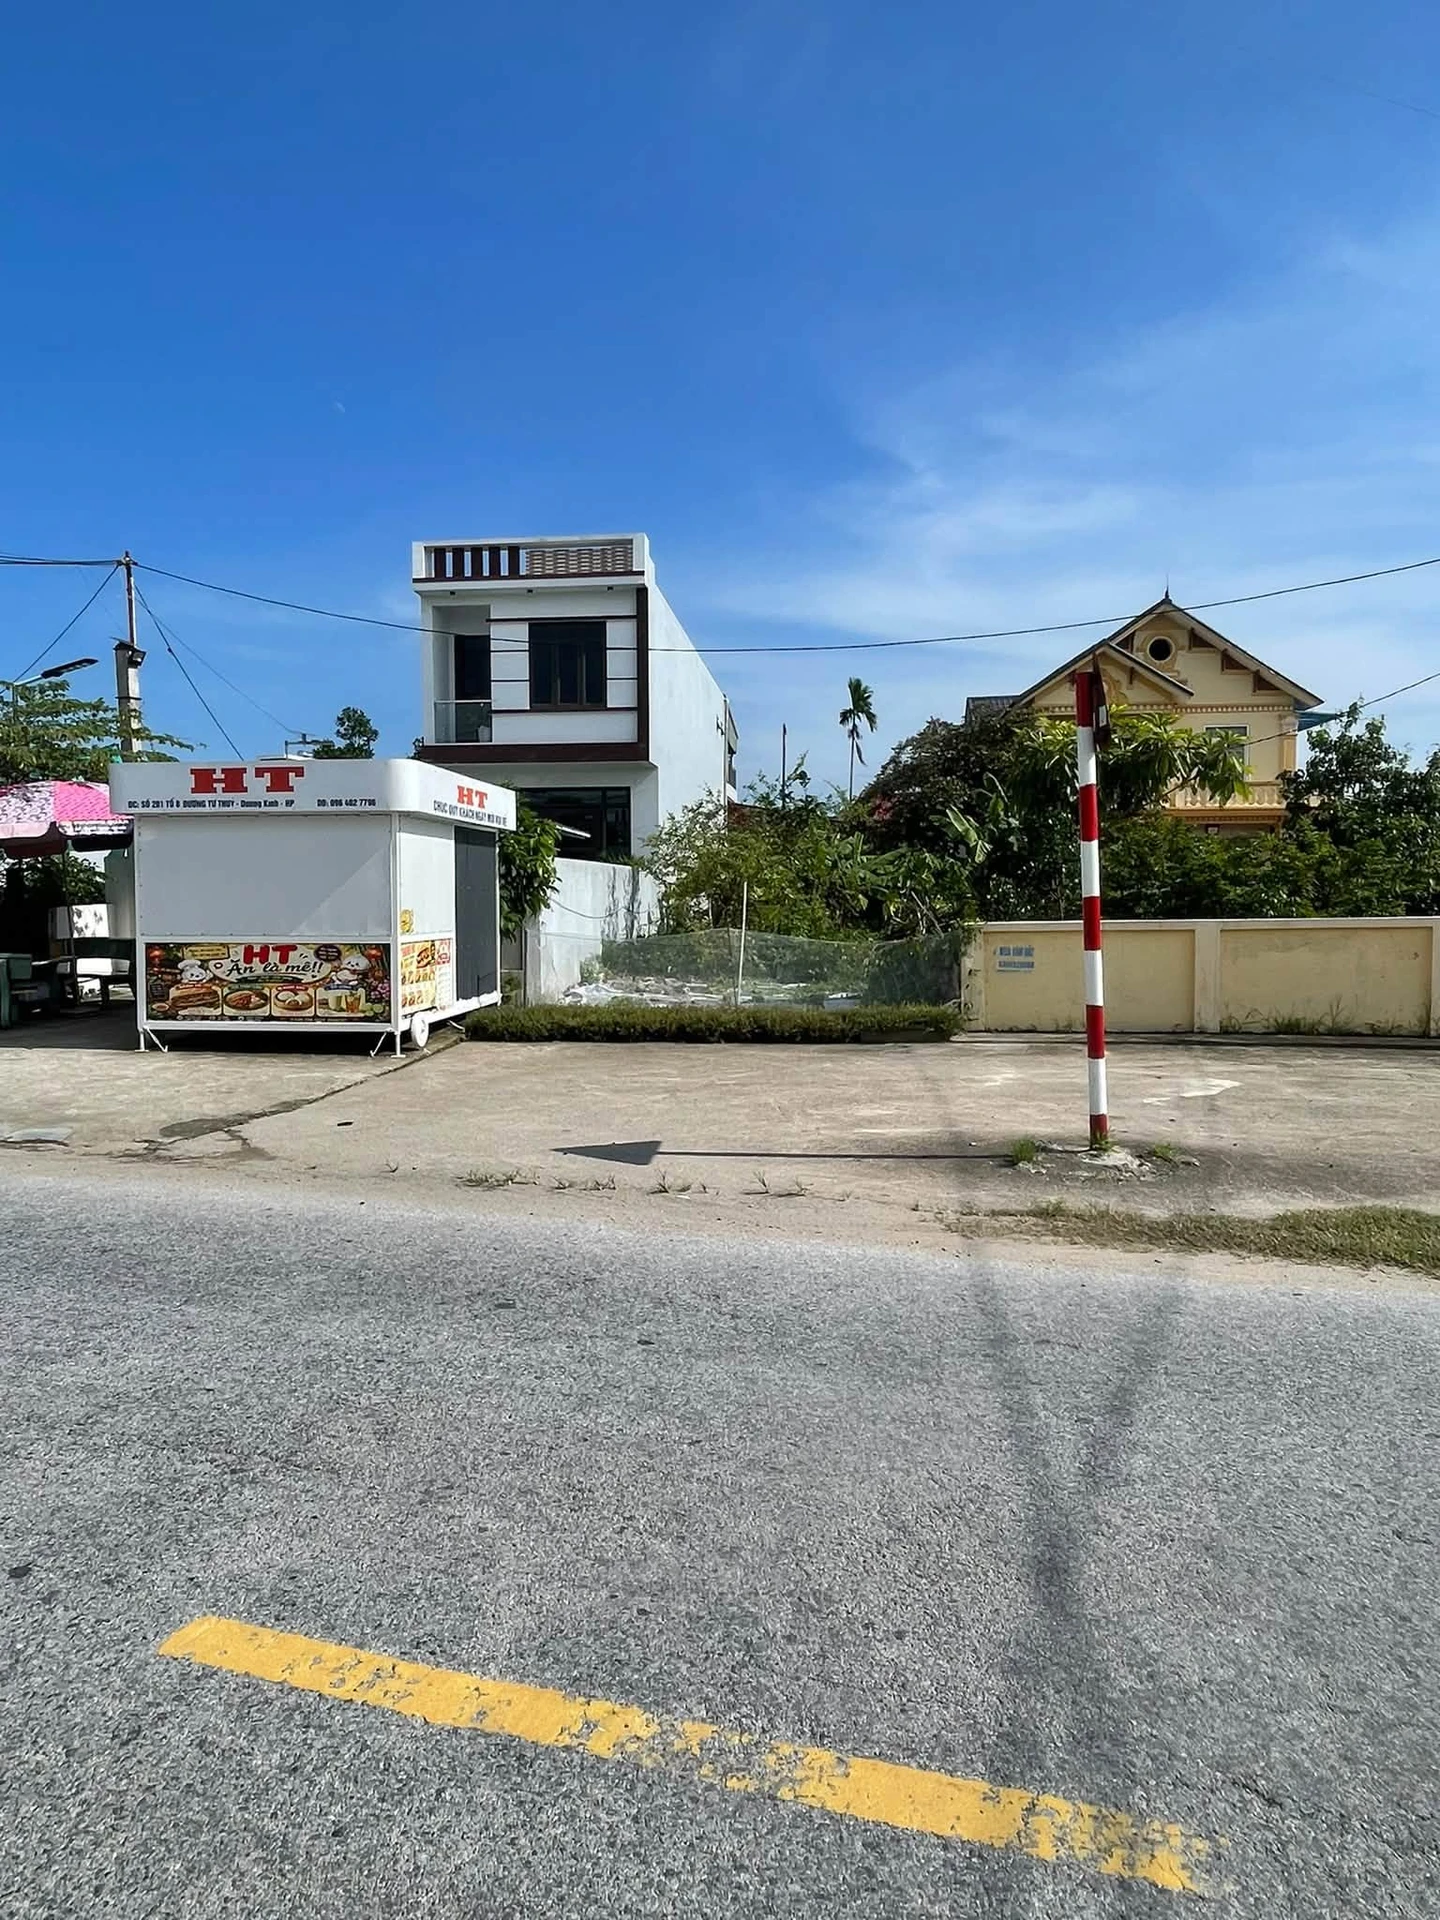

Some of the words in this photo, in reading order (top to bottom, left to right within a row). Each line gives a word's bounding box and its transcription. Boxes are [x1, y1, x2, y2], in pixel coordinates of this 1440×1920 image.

[189, 766, 305, 794] HT
[457, 785, 488, 809] HT
[243, 944, 298, 965] HT
[225, 959, 255, 977] Ăn
[263, 962, 280, 973] là
